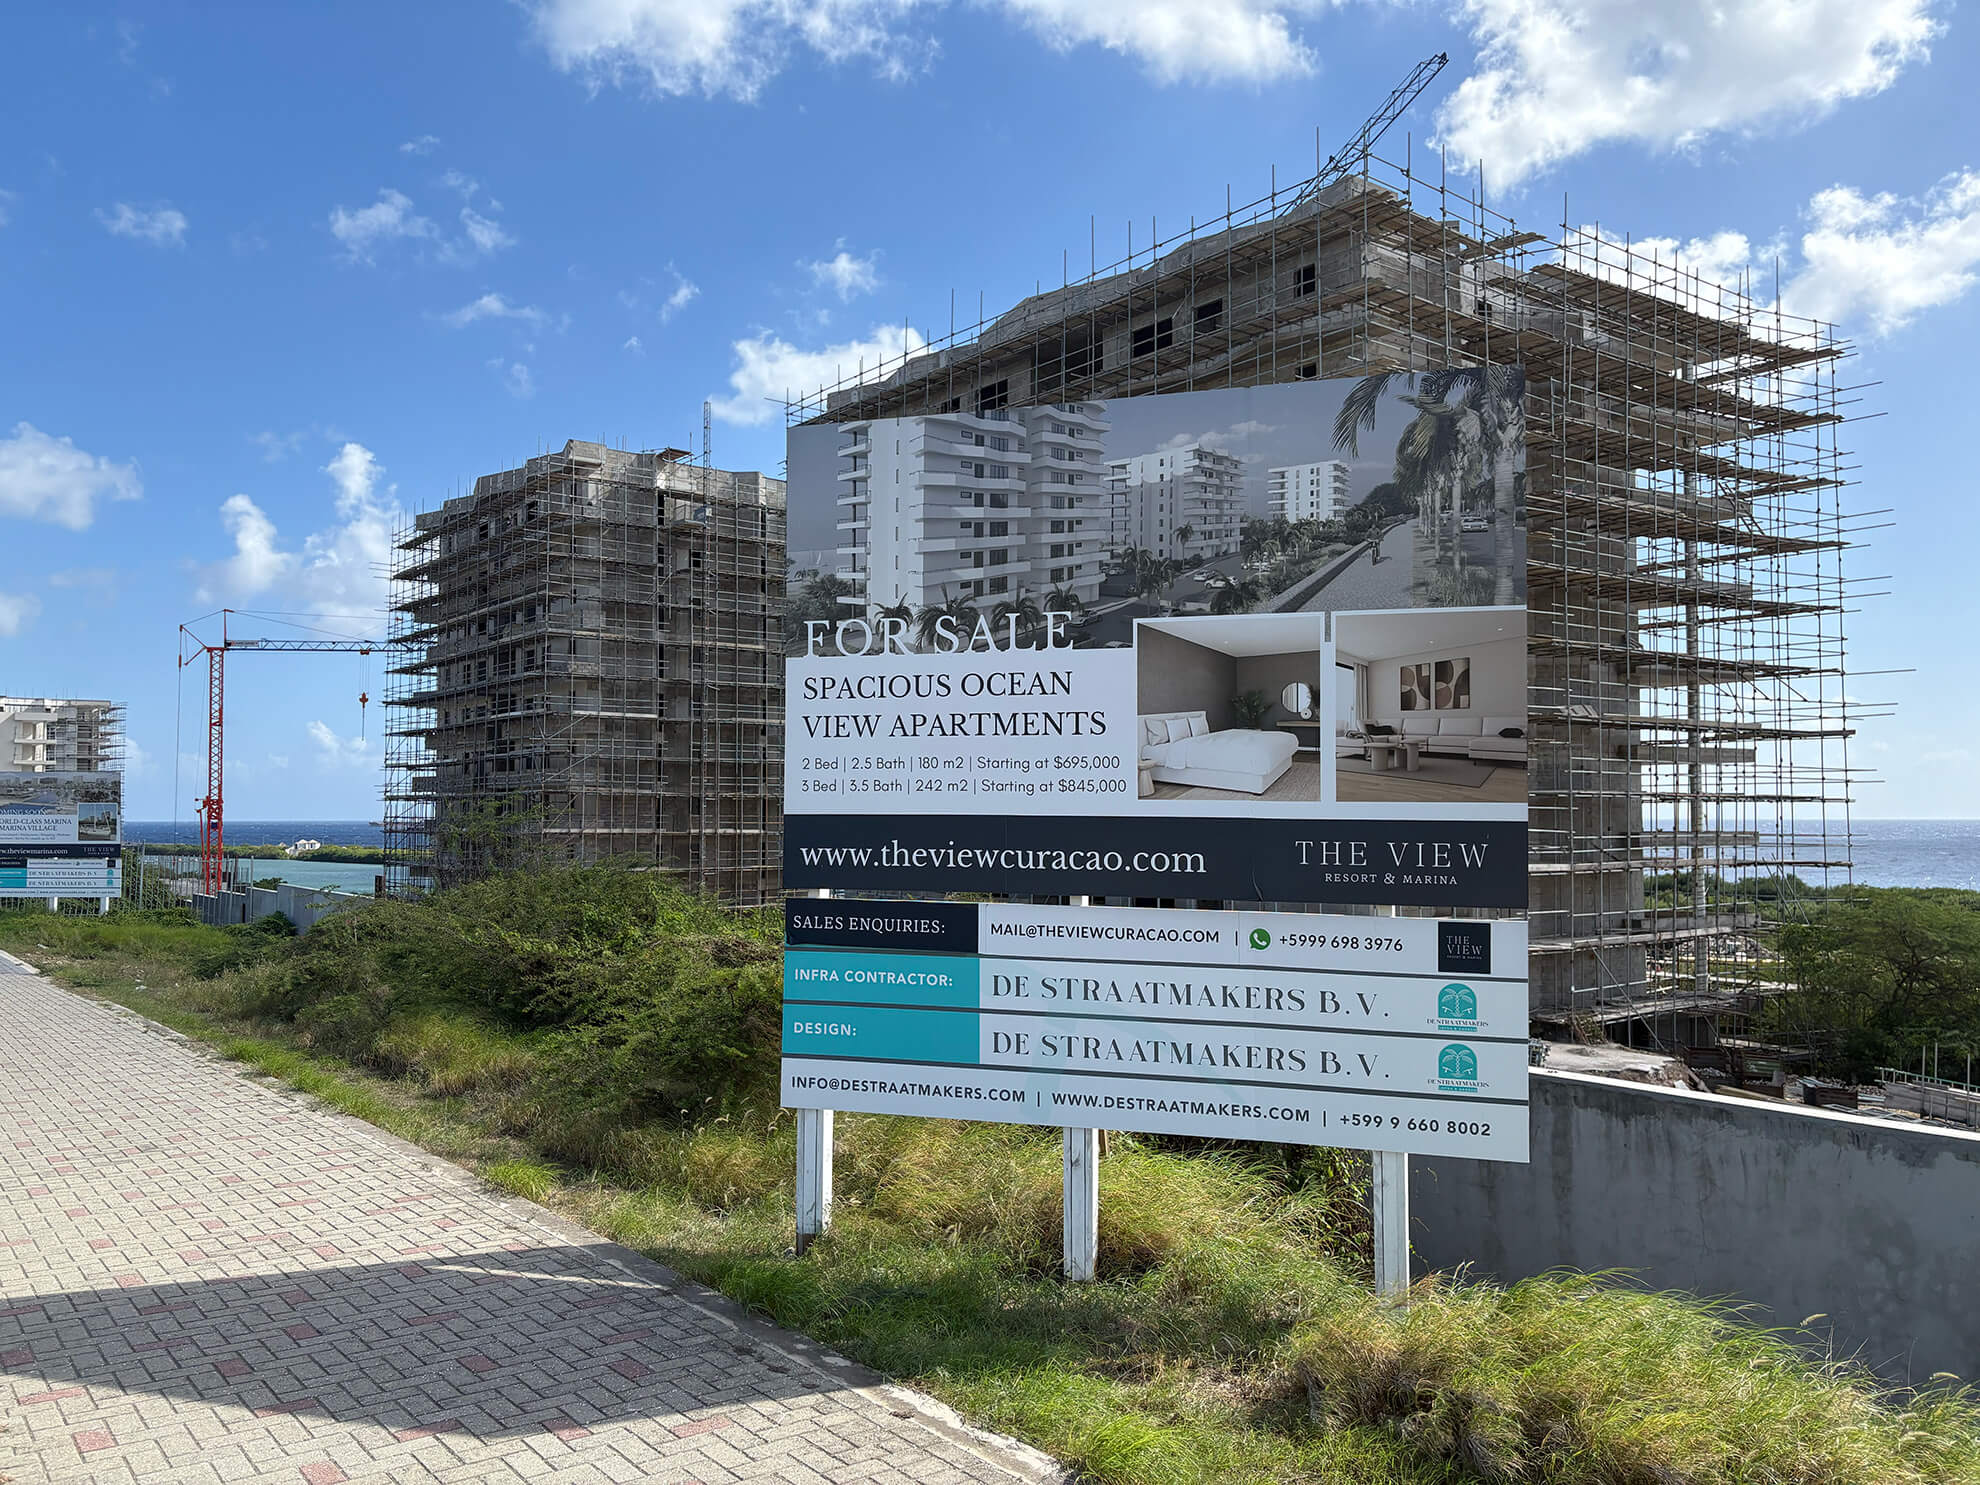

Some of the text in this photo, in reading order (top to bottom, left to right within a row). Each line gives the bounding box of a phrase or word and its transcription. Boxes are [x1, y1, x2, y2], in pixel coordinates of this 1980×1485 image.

[804, 611, 1075, 658] FOR SALE
[803, 671, 1074, 700] SPACIOUS OCEAN
[802, 710, 1107, 738] VIEW APARTMENTS
[802, 756, 1120, 773] 2 Bed 2.5 Bath 180 m2 Starting at $695,000
[802, 778, 1128, 796] 3 Bed 3.5 Bath 242 m2 Starting at $845,000
[800, 840, 1206, 874] www.theviewcuracao.com
[1295, 841, 1489, 868] THE VIEW
[1325, 873, 1458, 885] RESORT & MARINA
[793, 914, 946, 934] SALES ENQUIRIES:
[990, 922, 1220, 944] MAIL@THEVIEWCURACAO.COM
[1279, 934, 1404, 952] +5999 698 3976
[1446, 936, 1470, 945] THE
[1446, 944, 1482, 955] VIEW
[794, 968, 954, 987] INFRA CONTRACTOR:
[993, 974, 1390, 1018] DE STRAATMAKERS B.V.
[794, 1022, 857, 1037] DESIGN:
[993, 1031, 1390, 1078] DE STRAATMAKERS B.V.
[792, 1076, 1026, 1102] INFO@DESTRAATMAKERS.COM
[1052, 1092, 1310, 1122] WWW.DESTRAATMAKERS.COM
[1340, 1113, 1491, 1136] +599 9 660 8002
